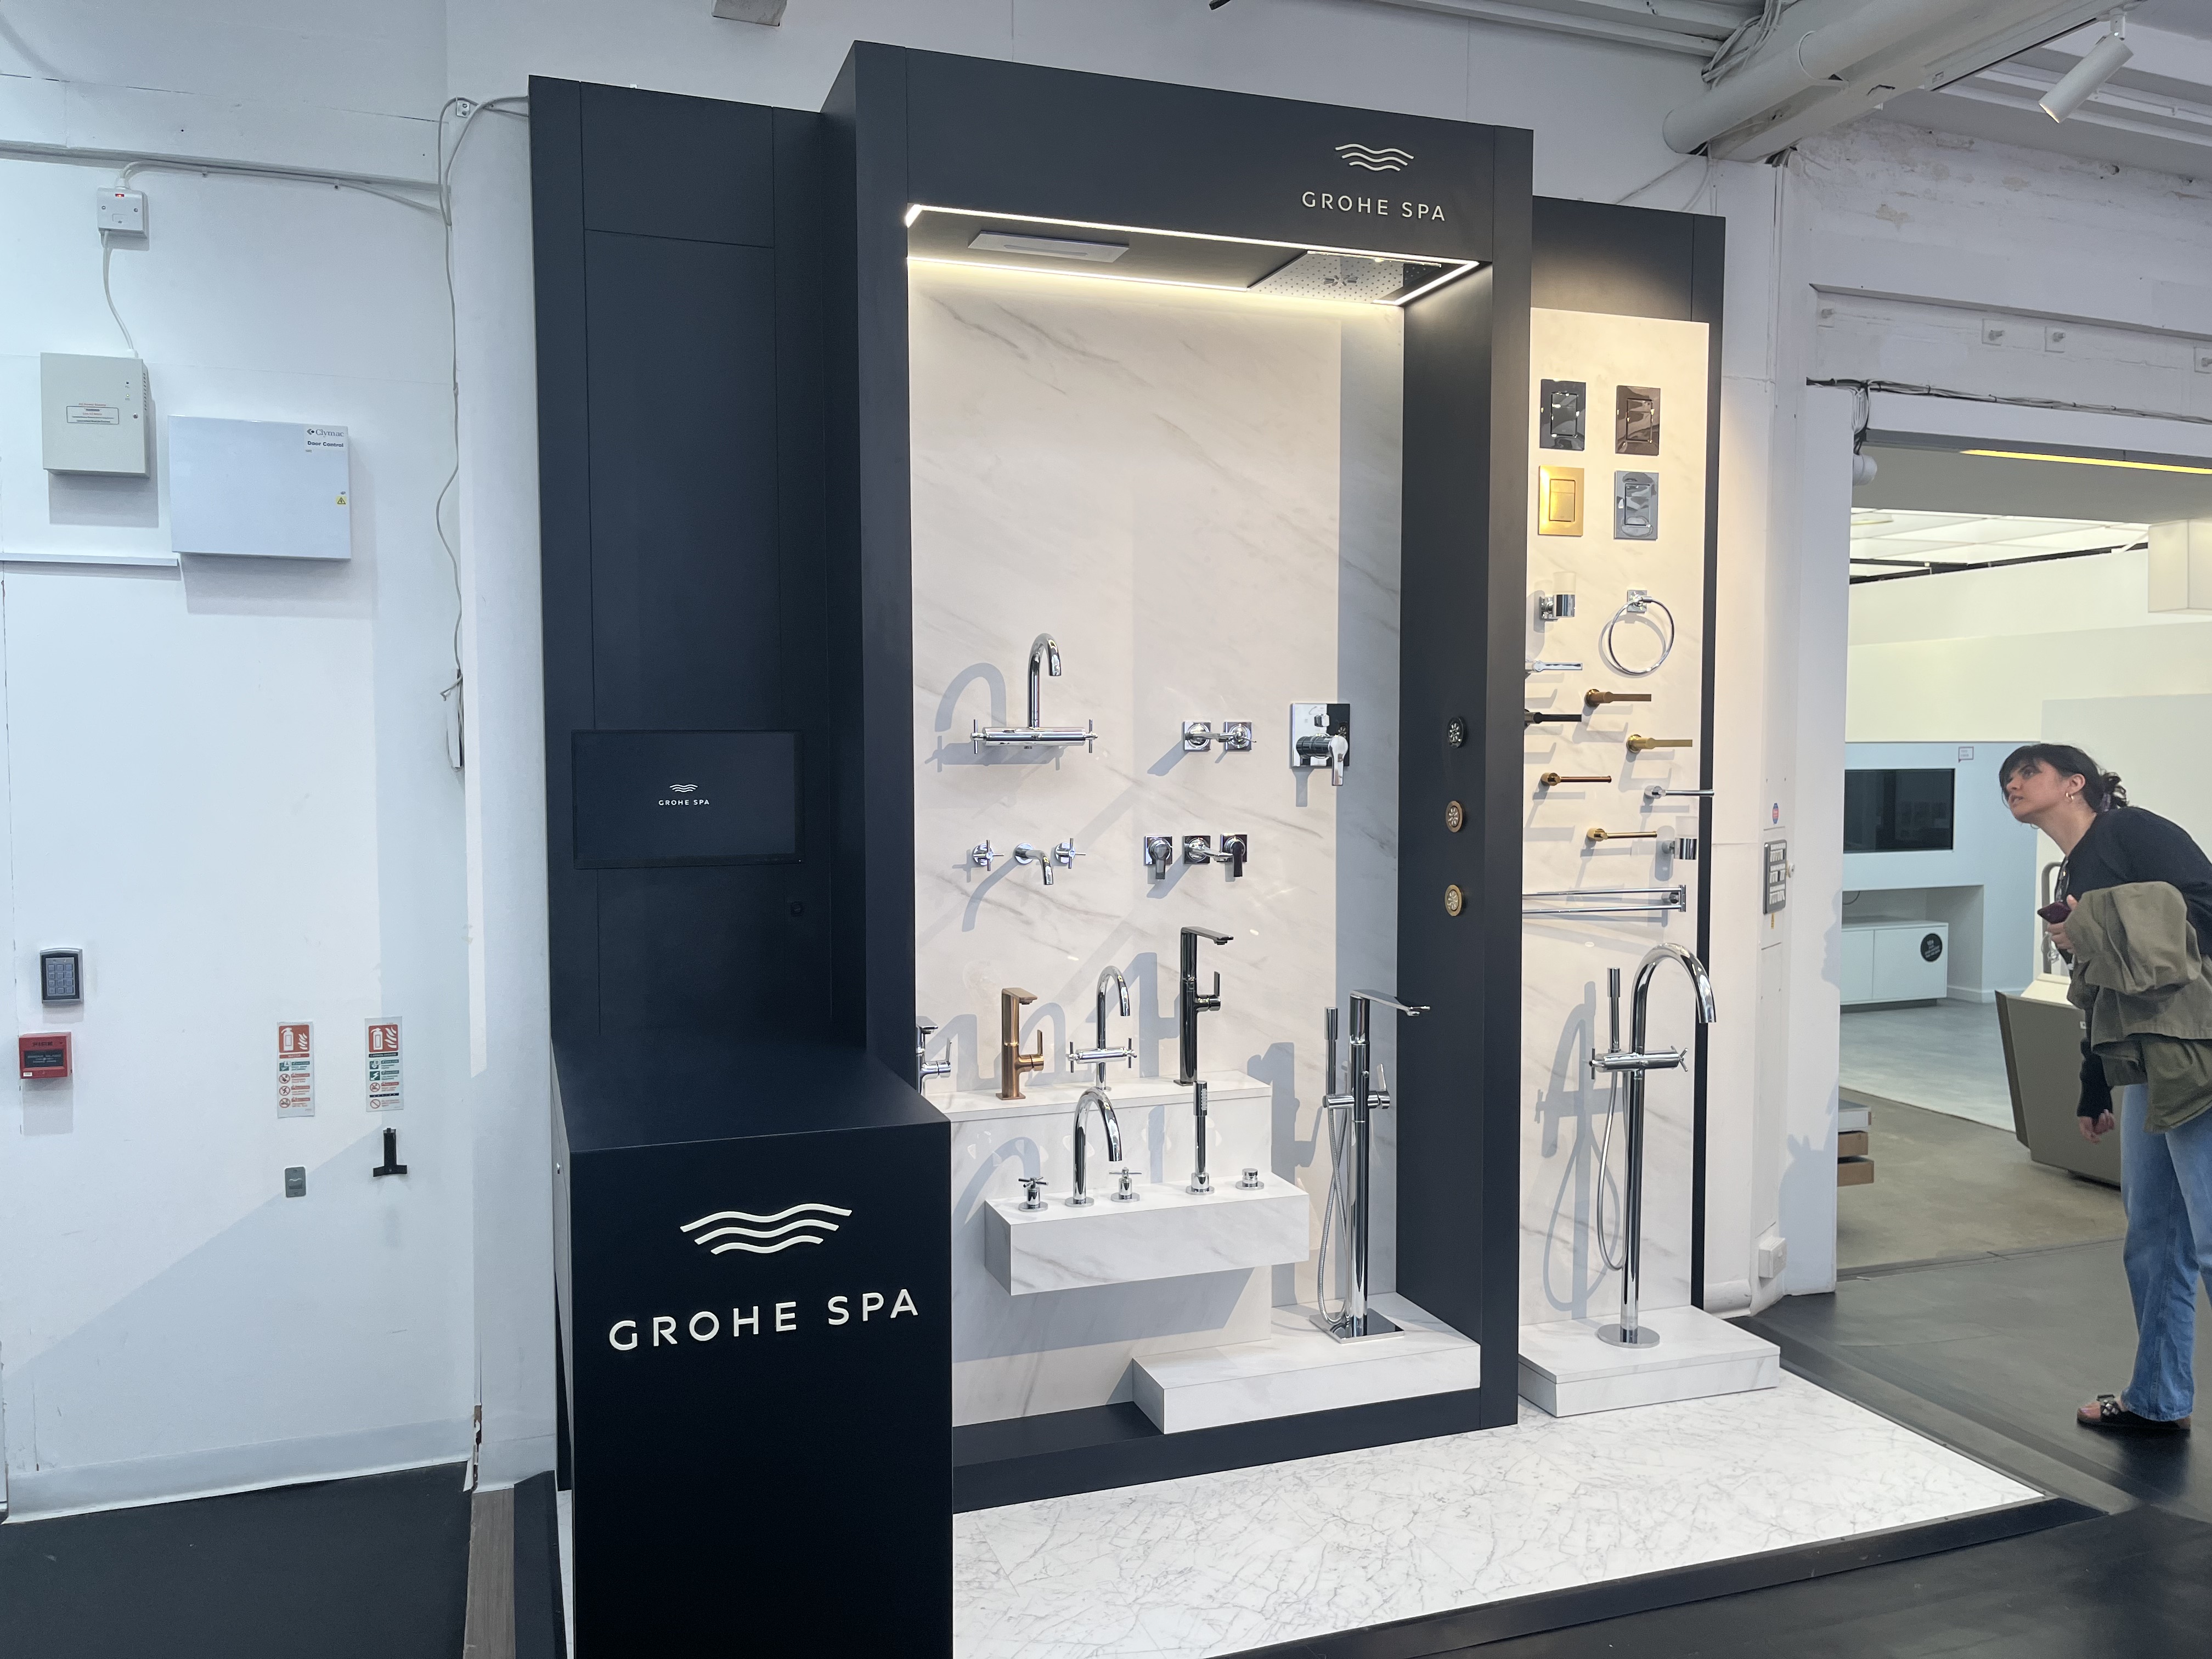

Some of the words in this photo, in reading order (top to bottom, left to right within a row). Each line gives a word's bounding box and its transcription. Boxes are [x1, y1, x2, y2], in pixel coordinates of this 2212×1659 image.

[1301, 191, 1389, 216] GROHE
[1401, 202, 1446, 222] SPA
[315, 429, 345, 438] Clymac
[608, 1301, 797, 1351] GROHE
[827, 1288, 919, 1326] SPA
